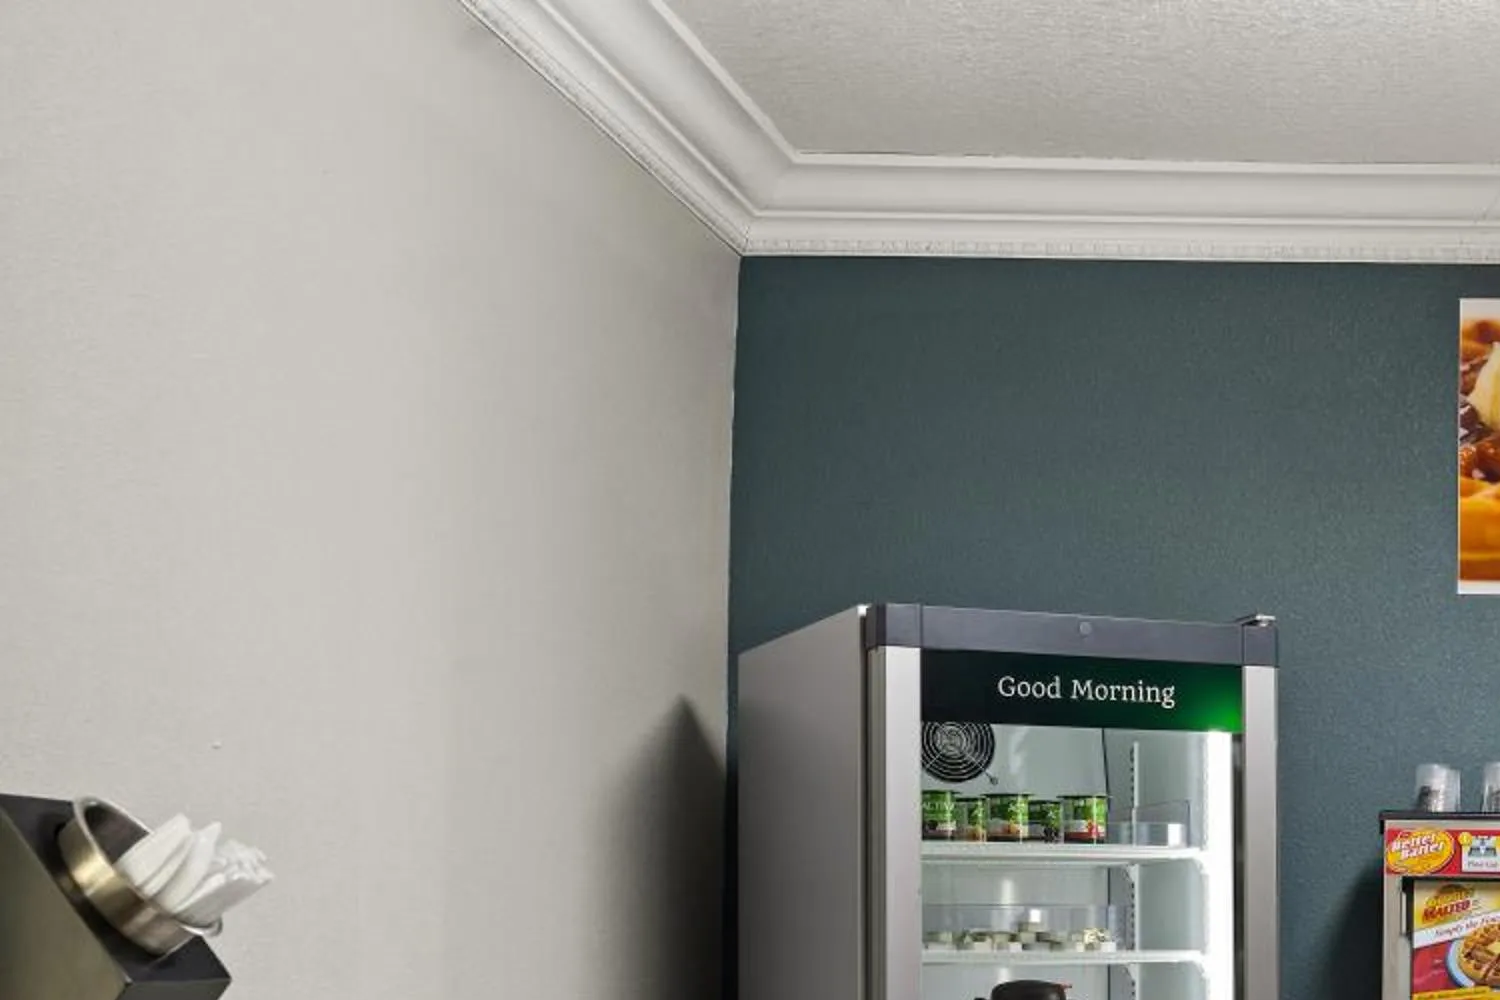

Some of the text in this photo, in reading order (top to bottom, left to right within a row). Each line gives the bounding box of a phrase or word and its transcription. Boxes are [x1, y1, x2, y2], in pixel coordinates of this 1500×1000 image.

[997, 675, 1176, 708] Good Morning
[1422, 898, 1472, 923] MALTED
